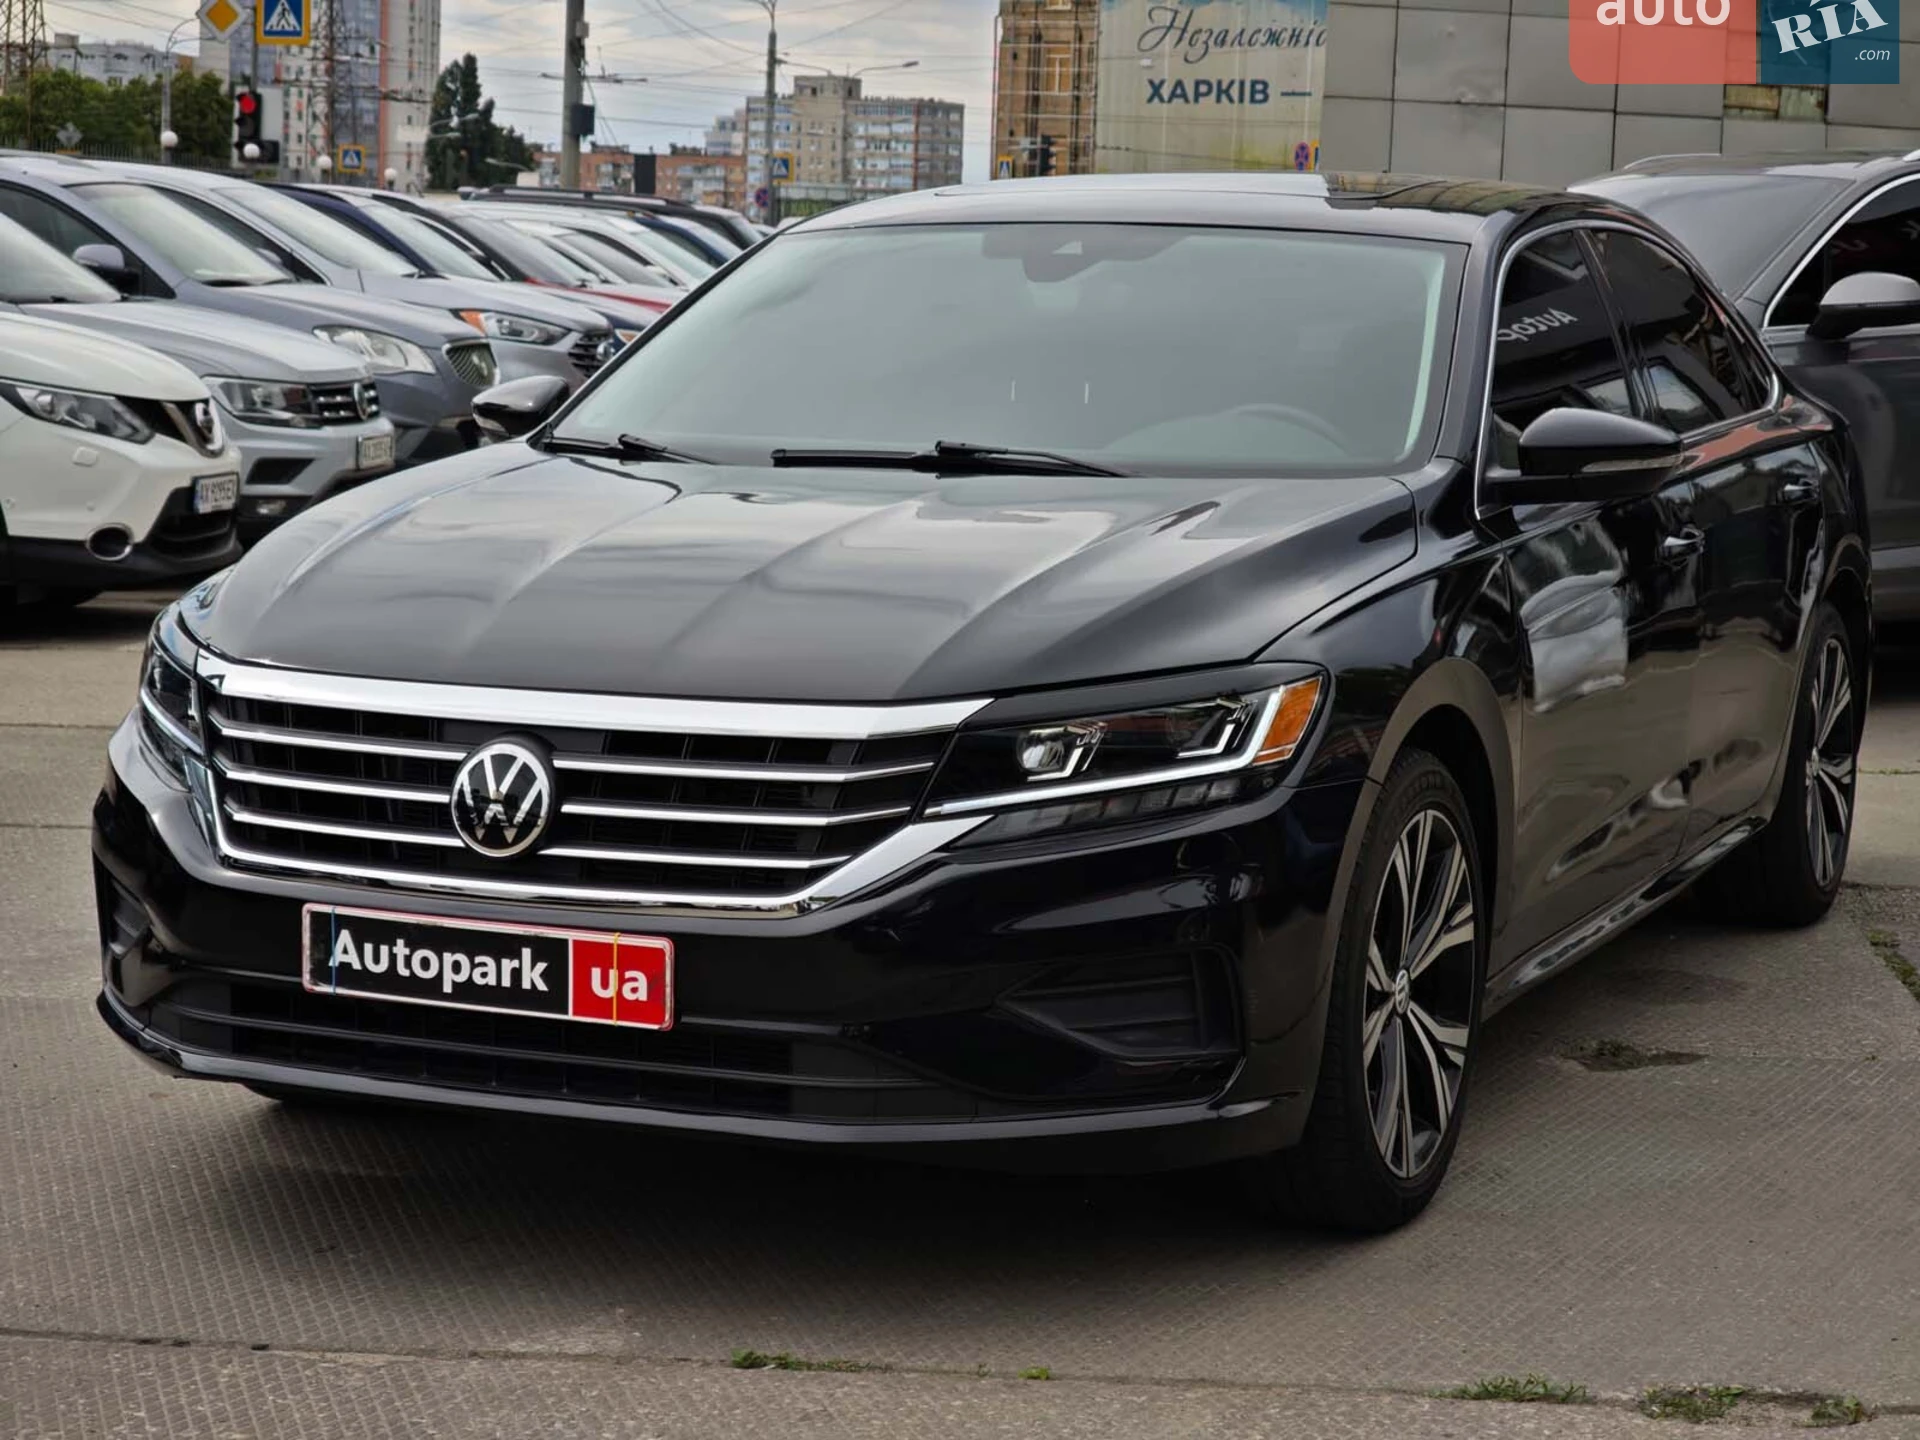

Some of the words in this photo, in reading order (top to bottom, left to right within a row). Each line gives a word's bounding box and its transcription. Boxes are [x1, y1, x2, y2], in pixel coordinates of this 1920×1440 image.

[1147, 78, 1270, 105] ХАРКІВ
[328, 928, 549, 993] Autopark
[590, 965, 648, 1002] ua
